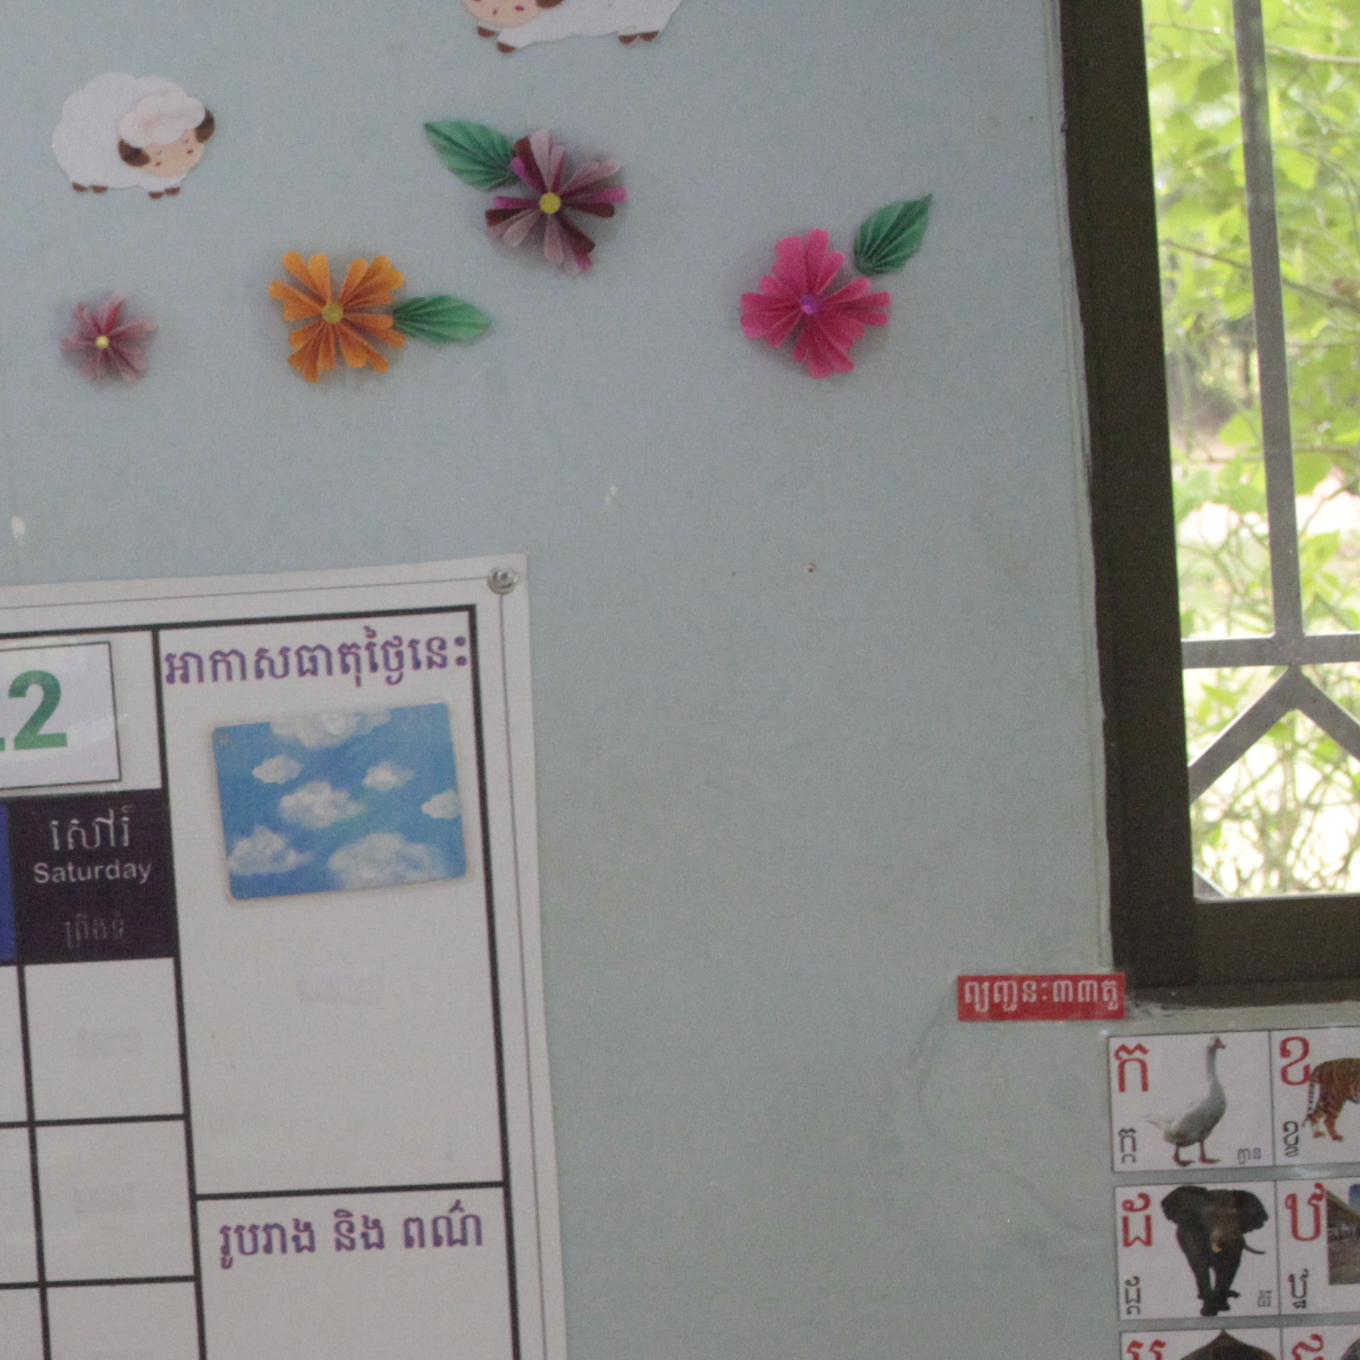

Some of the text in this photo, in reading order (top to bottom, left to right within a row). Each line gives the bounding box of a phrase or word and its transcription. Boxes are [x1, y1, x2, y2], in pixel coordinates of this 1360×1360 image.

[165, 625, 468, 687] អាកាសធាតុថ្ងៃនេះ
[33, 860, 152, 884] Saturday
[1114, 1043, 1150, 1093] ក
[1280, 1036, 1310, 1085] ខ
[333, 1208, 384, 1251] និង
[1121, 1193, 1153, 1248] ដ
